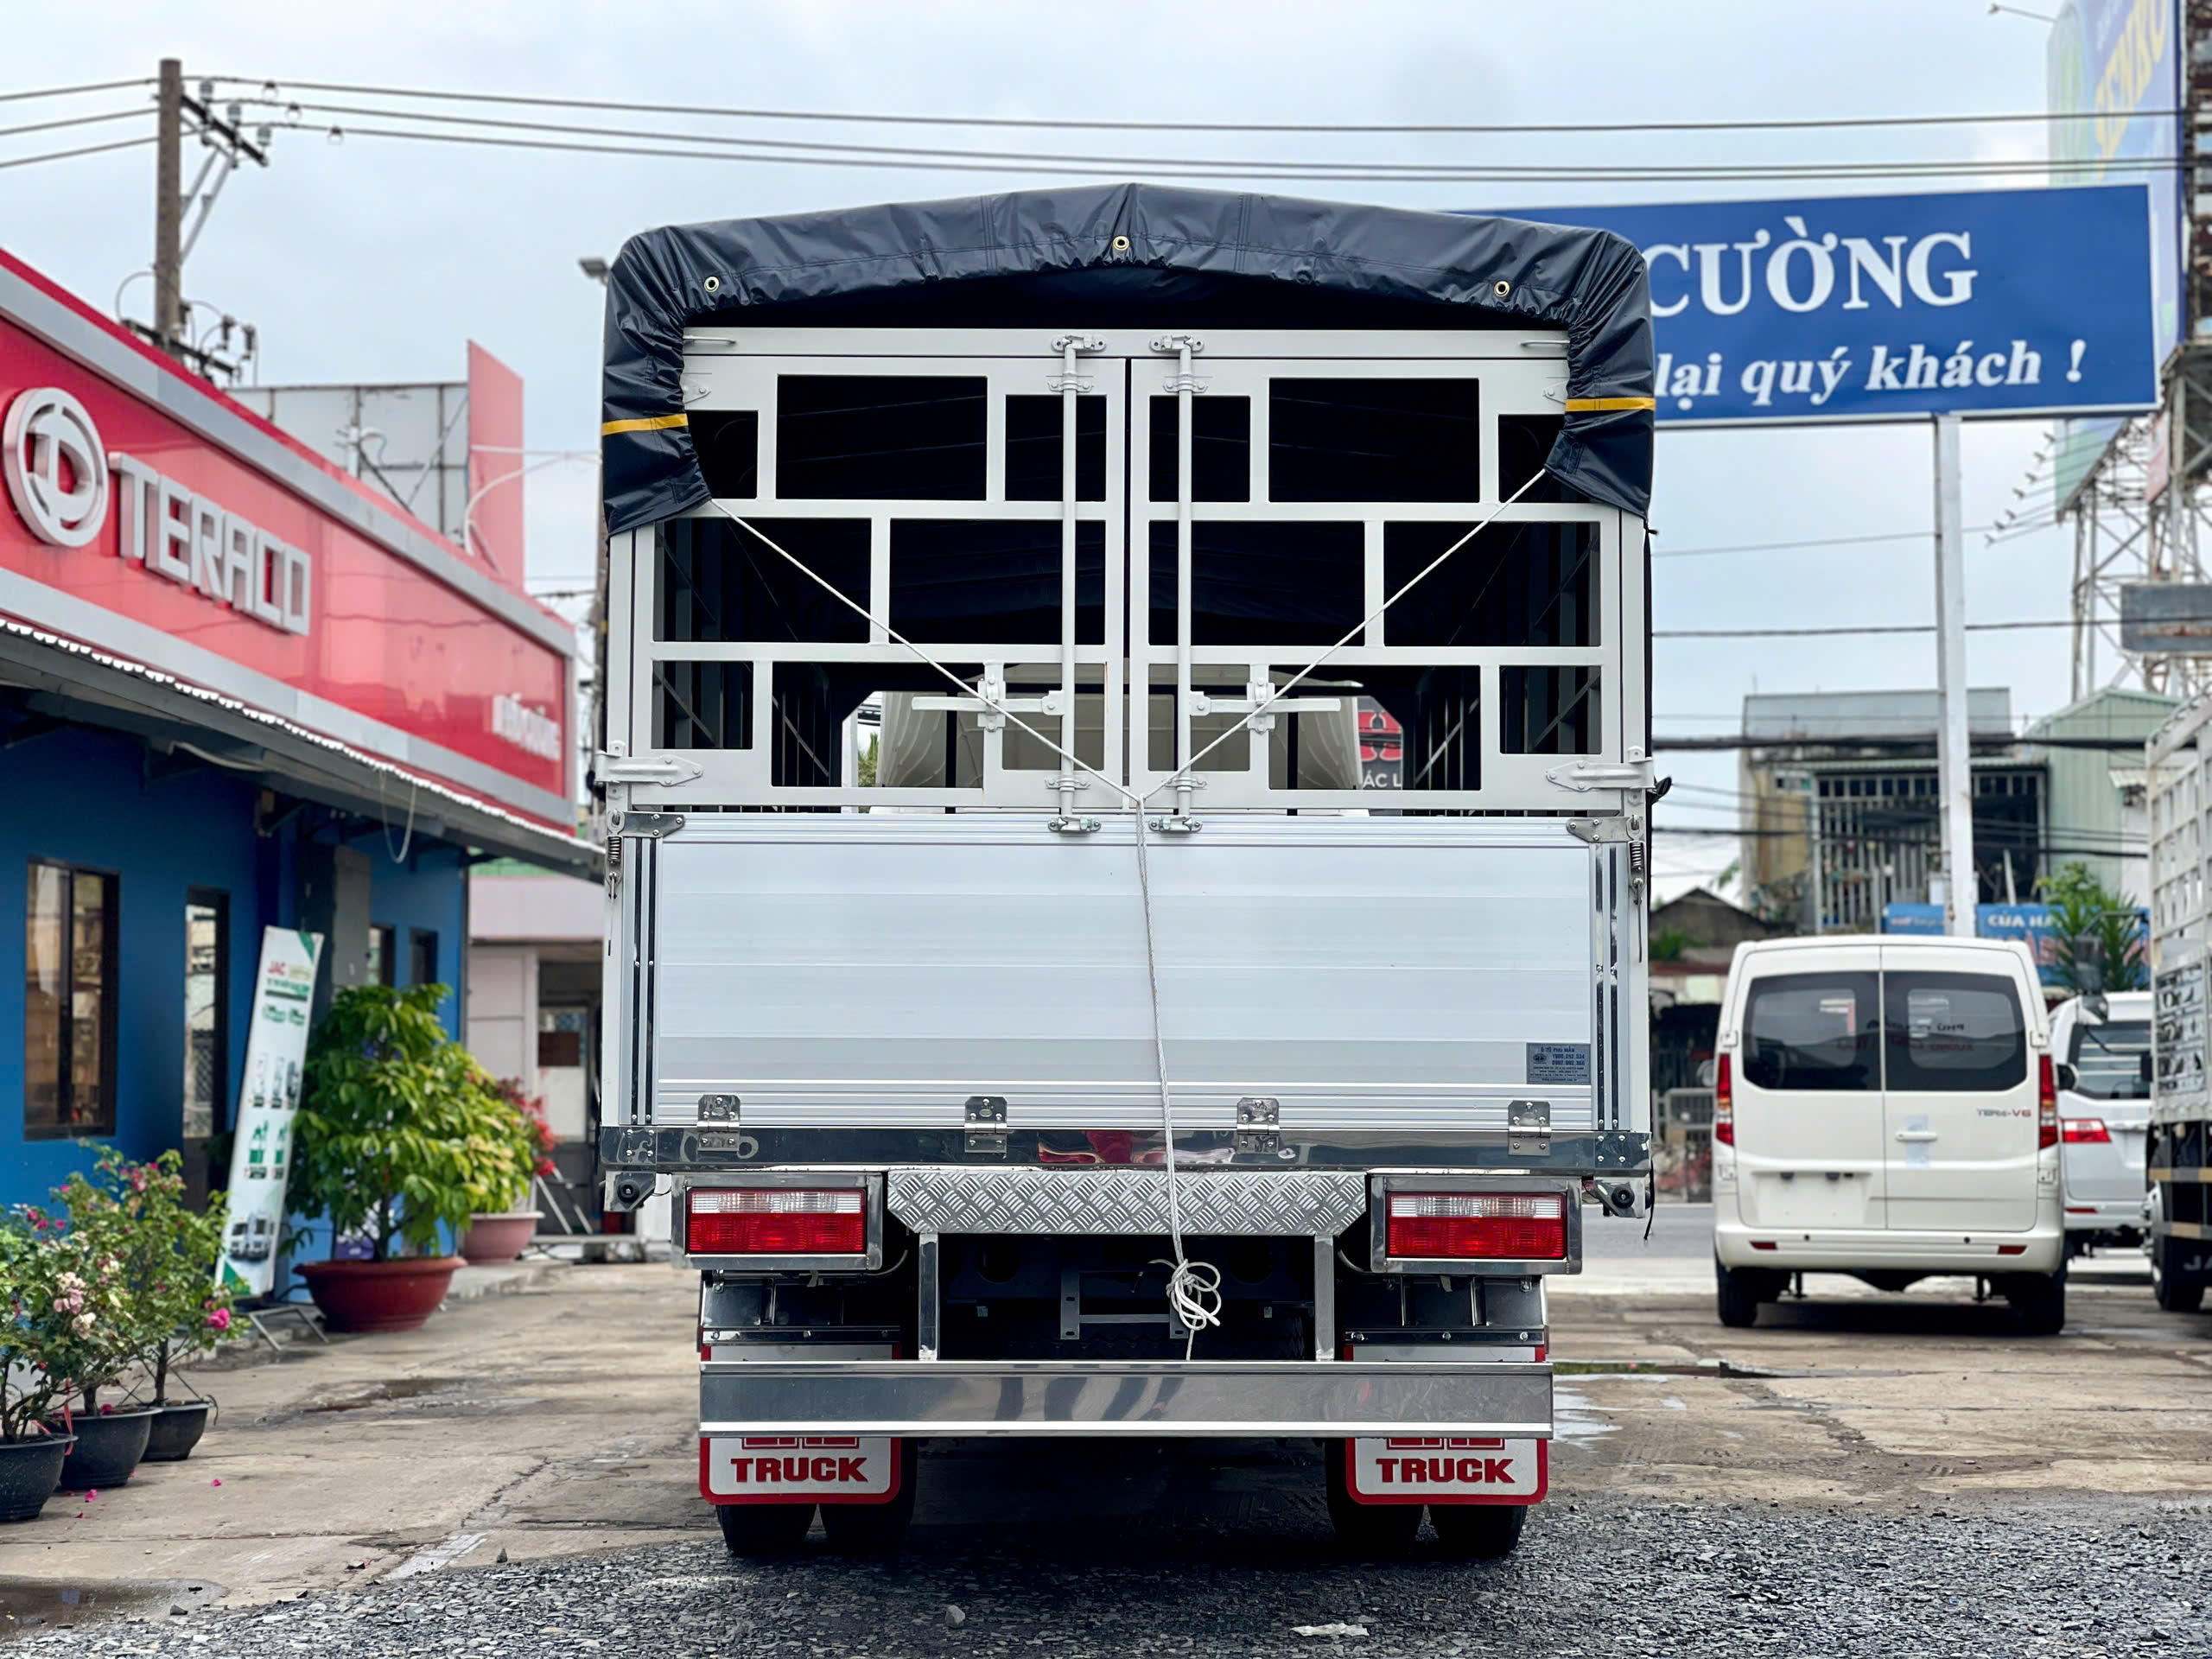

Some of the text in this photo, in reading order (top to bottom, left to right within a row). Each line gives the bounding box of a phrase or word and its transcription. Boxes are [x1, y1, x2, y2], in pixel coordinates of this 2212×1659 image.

[1642, 216, 1979, 318] CƯỜNG
[1654, 353, 1723, 410] lại
[1740, 346, 1853, 406] quý
[1865, 340, 2042, 391] khách
[109, 452, 311, 637] TERACO
[730, 1457, 868, 1483] TRUCK
[1376, 1458, 1516, 1484] TRUCK
